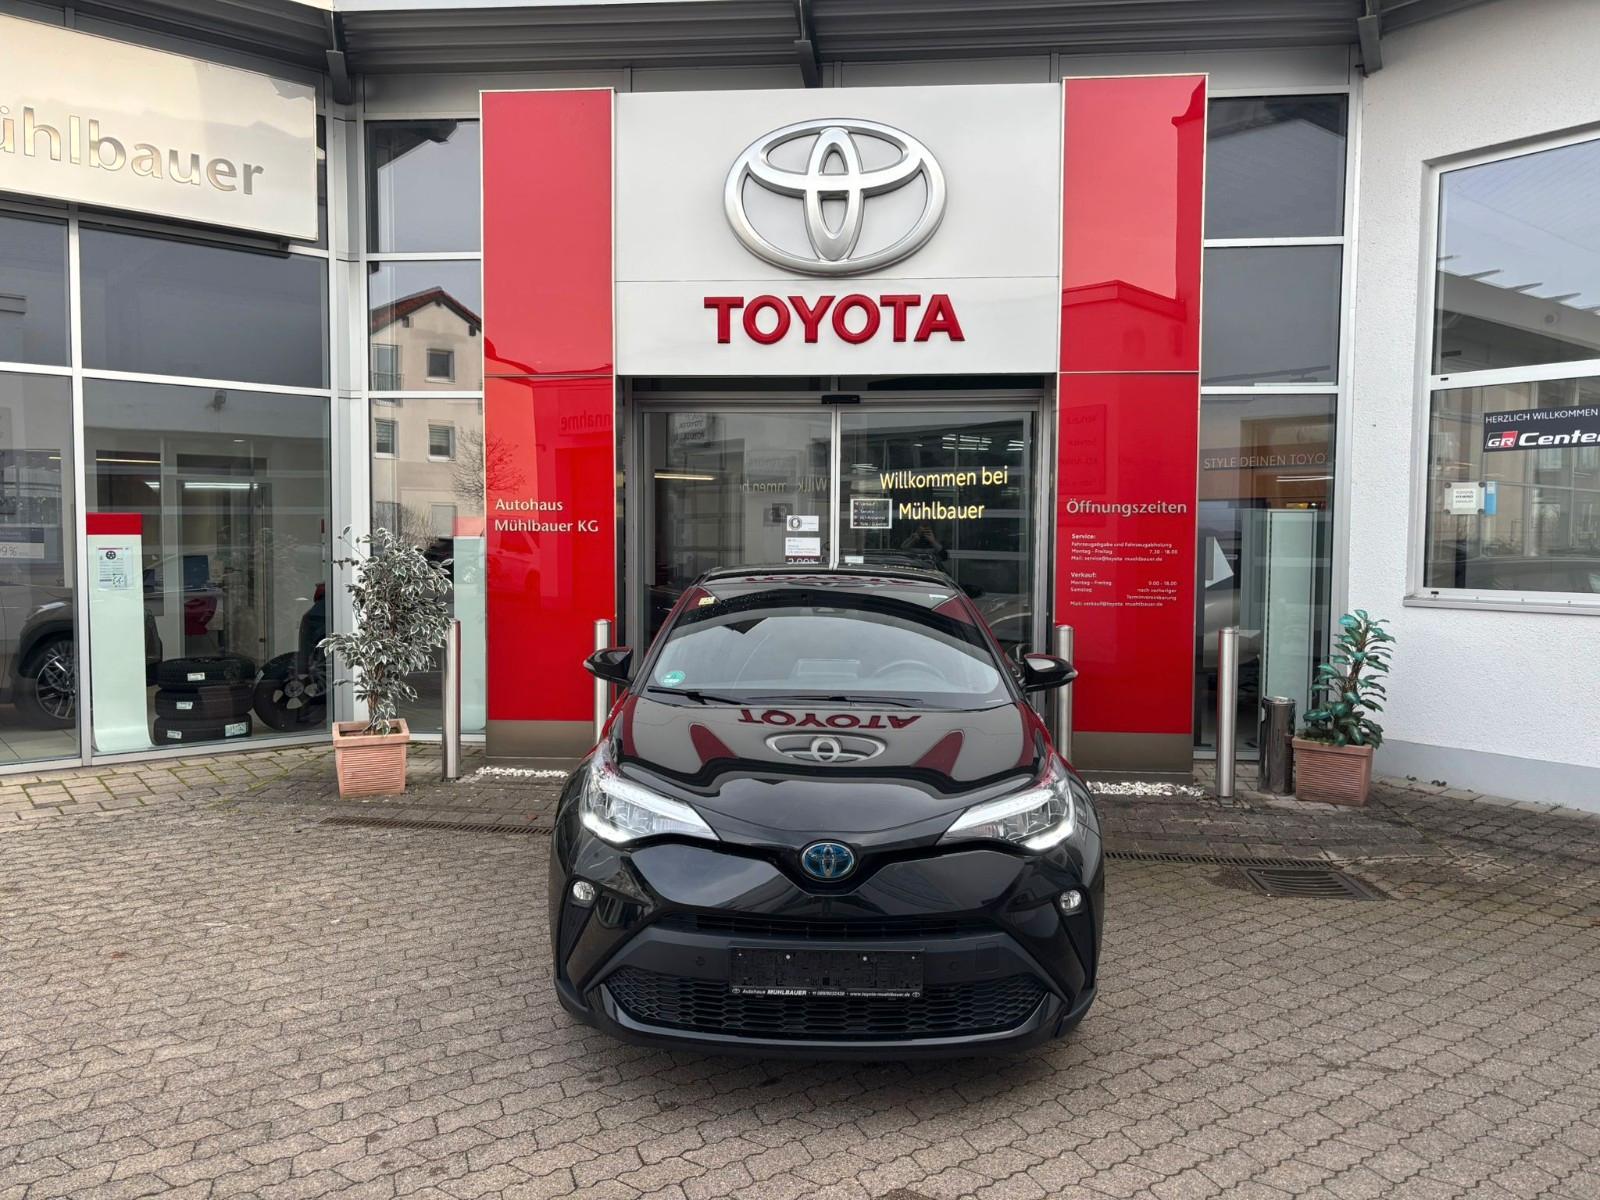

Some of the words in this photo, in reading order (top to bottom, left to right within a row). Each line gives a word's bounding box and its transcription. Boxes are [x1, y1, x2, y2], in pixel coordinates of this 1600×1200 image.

[703, 293, 966, 345] TOYOTA
[1485, 413, 1530, 424] HERZLICH
[1532, 408, 1598, 420] WILLKOMMEN
[1487, 437, 1514, 447] GR
[1203, 456, 1237, 469] STYLE
[1240, 455, 1285, 467] DEINEN
[879, 470, 977, 490] Willkommen
[981, 465, 1009, 485] bei
[495, 498, 564, 511] Autohaus
[899, 501, 985, 521] Mühlbauer
[1066, 498, 1188, 517] Öffnungszeiten
[494, 518, 574, 532] Mühlbauer
[577, 520, 599, 532] KG
